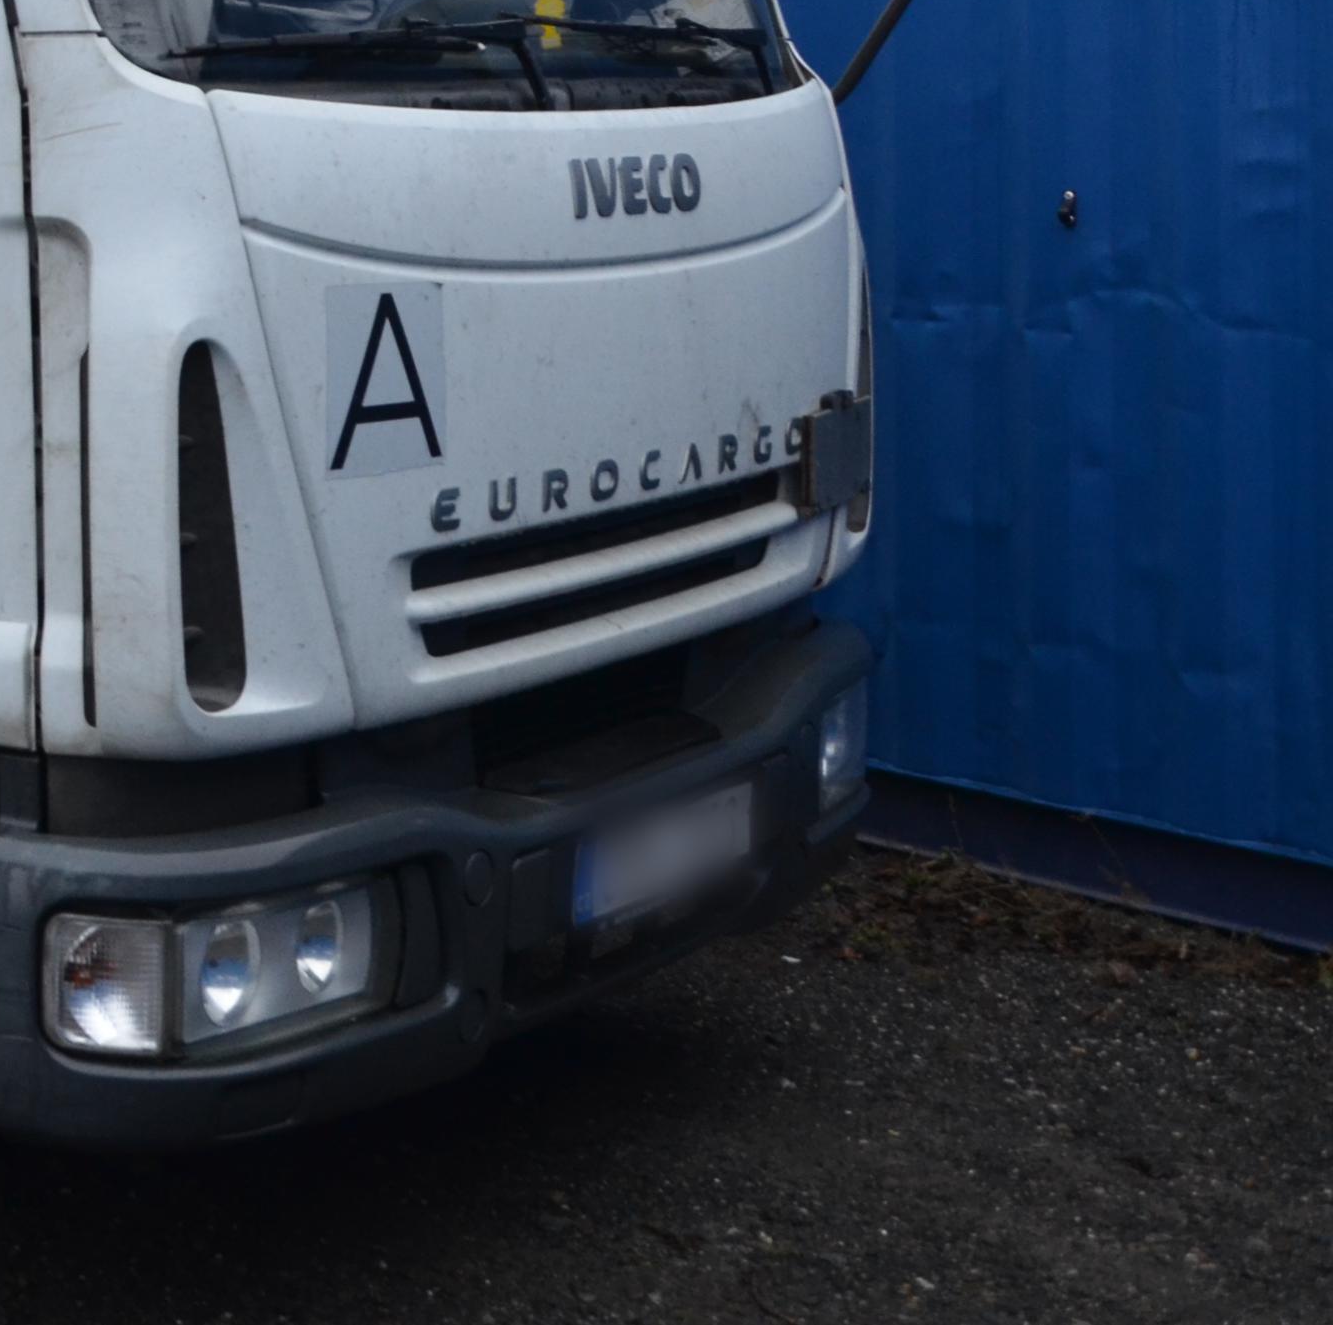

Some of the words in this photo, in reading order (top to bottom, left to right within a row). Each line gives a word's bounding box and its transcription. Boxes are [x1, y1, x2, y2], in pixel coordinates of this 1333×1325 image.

[568, 152, 702, 220] IVECO
[330, 292, 443, 471] A
[430, 416, 802, 532] EUROCARGO
